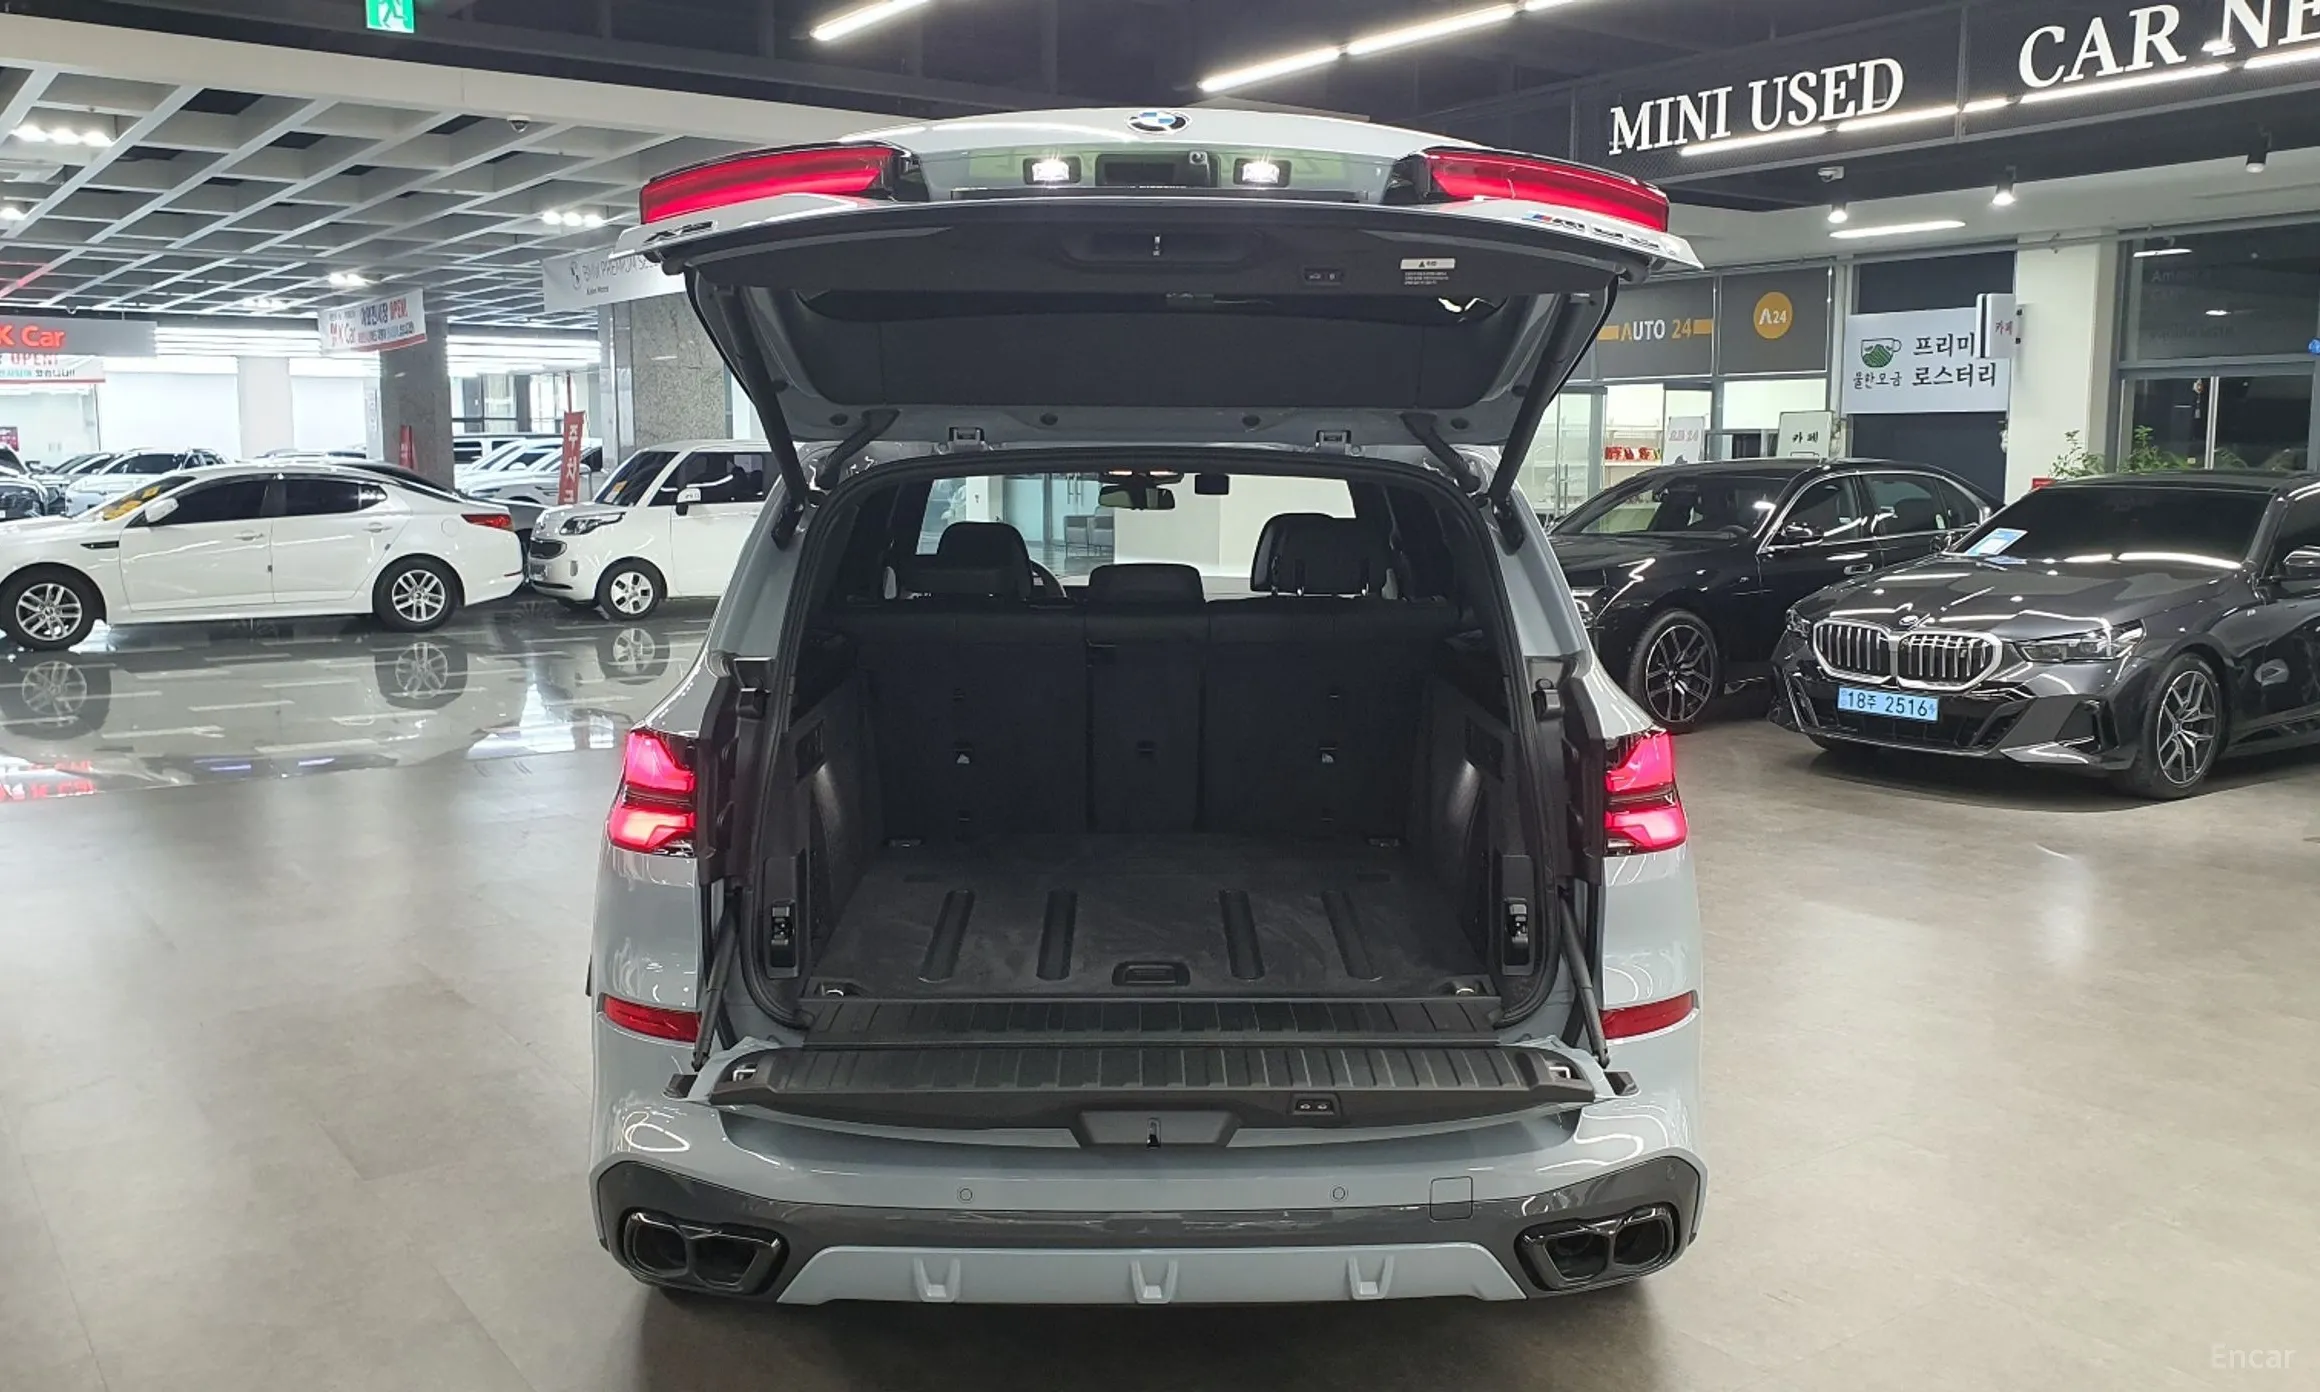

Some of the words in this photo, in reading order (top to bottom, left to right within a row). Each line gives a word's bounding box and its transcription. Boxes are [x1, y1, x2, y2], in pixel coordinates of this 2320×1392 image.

[2018, 4, 2187, 88] CAR
[1608, 86, 1733, 155] MINI
[1748, 57, 1904, 132] USED
[1758, 307, 1788, 326] A24
[0, 324, 15, 346] K
[21, 324, 66, 347] Car
[1620, 319, 1665, 342] AUTO
[1671, 318, 1693, 340] 24
[1912, 332, 1976, 358] 프리미
[1912, 362, 1997, 389] 로스터리
[1791, 430, 1819, 444] 카페
[1848, 690, 1877, 710] 18주
[1885, 696, 1928, 717] 2516
